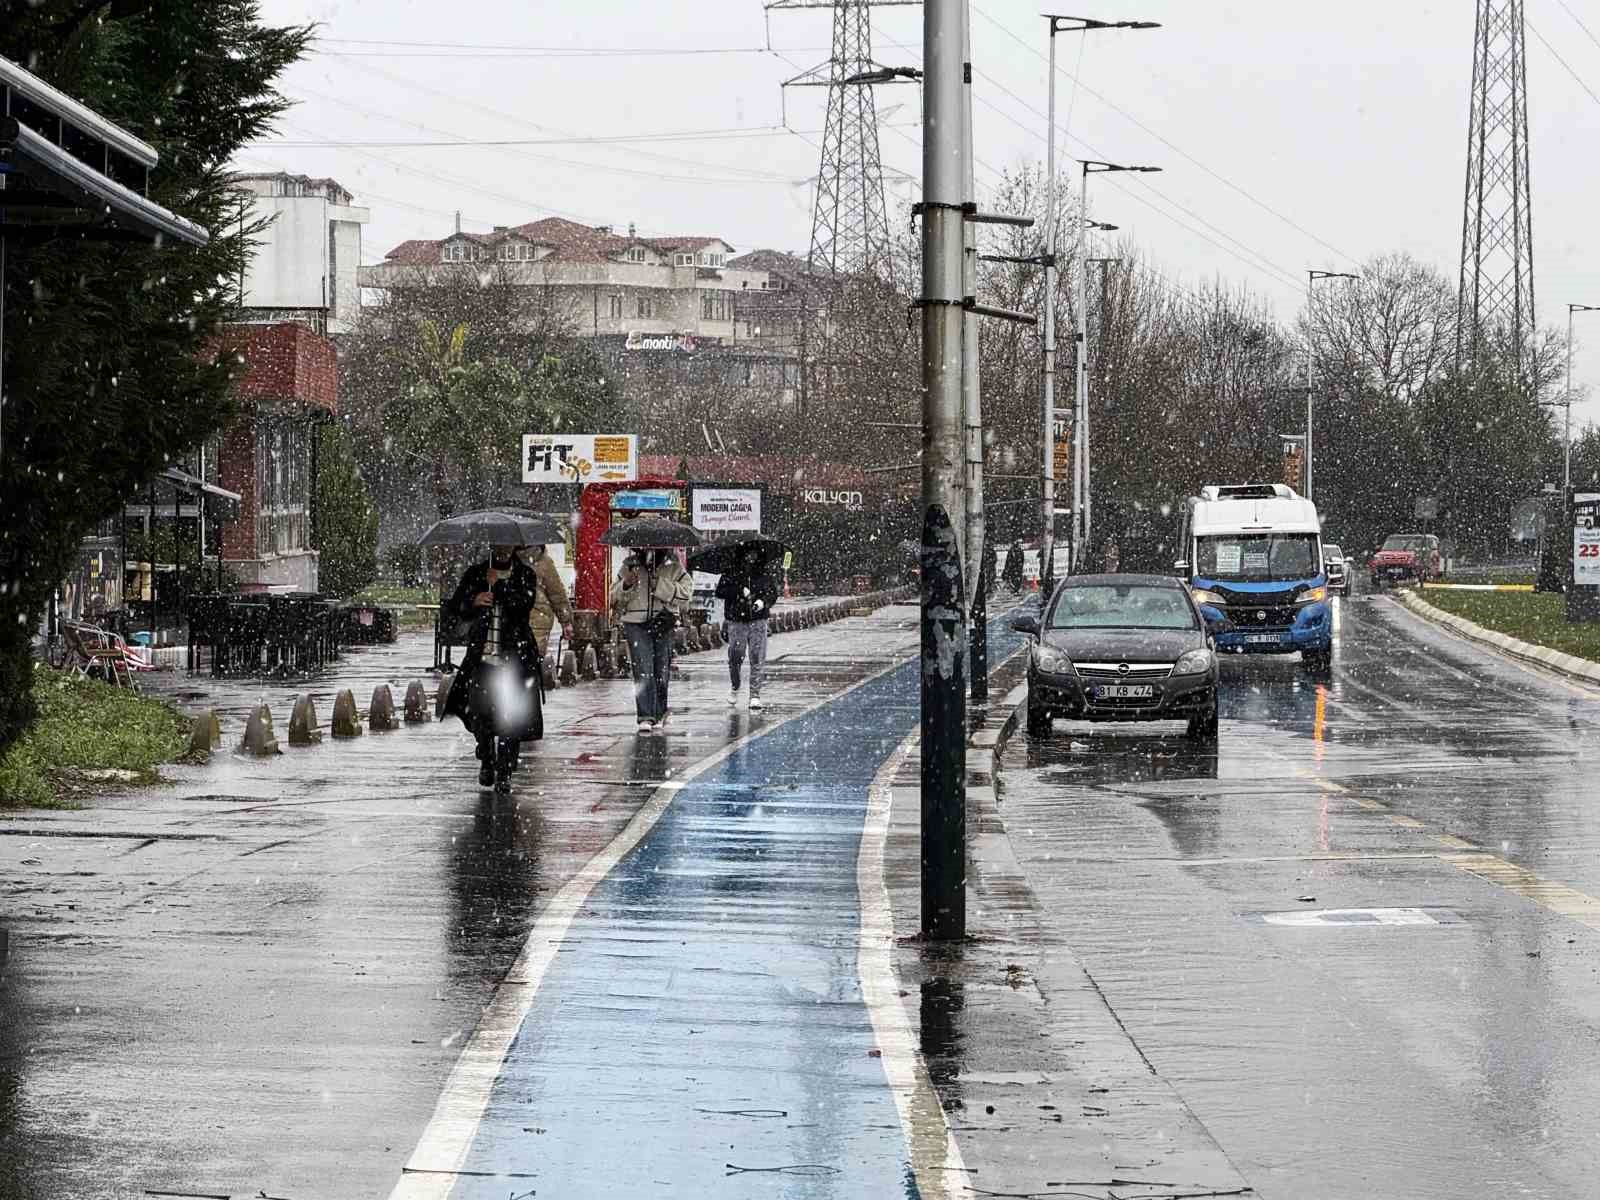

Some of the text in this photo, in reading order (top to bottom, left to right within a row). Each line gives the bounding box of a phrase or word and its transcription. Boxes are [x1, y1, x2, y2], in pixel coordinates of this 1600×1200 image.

[701, 503, 729, 512] MODERN
[1100, 686, 1152, 697] 81 KB 474
